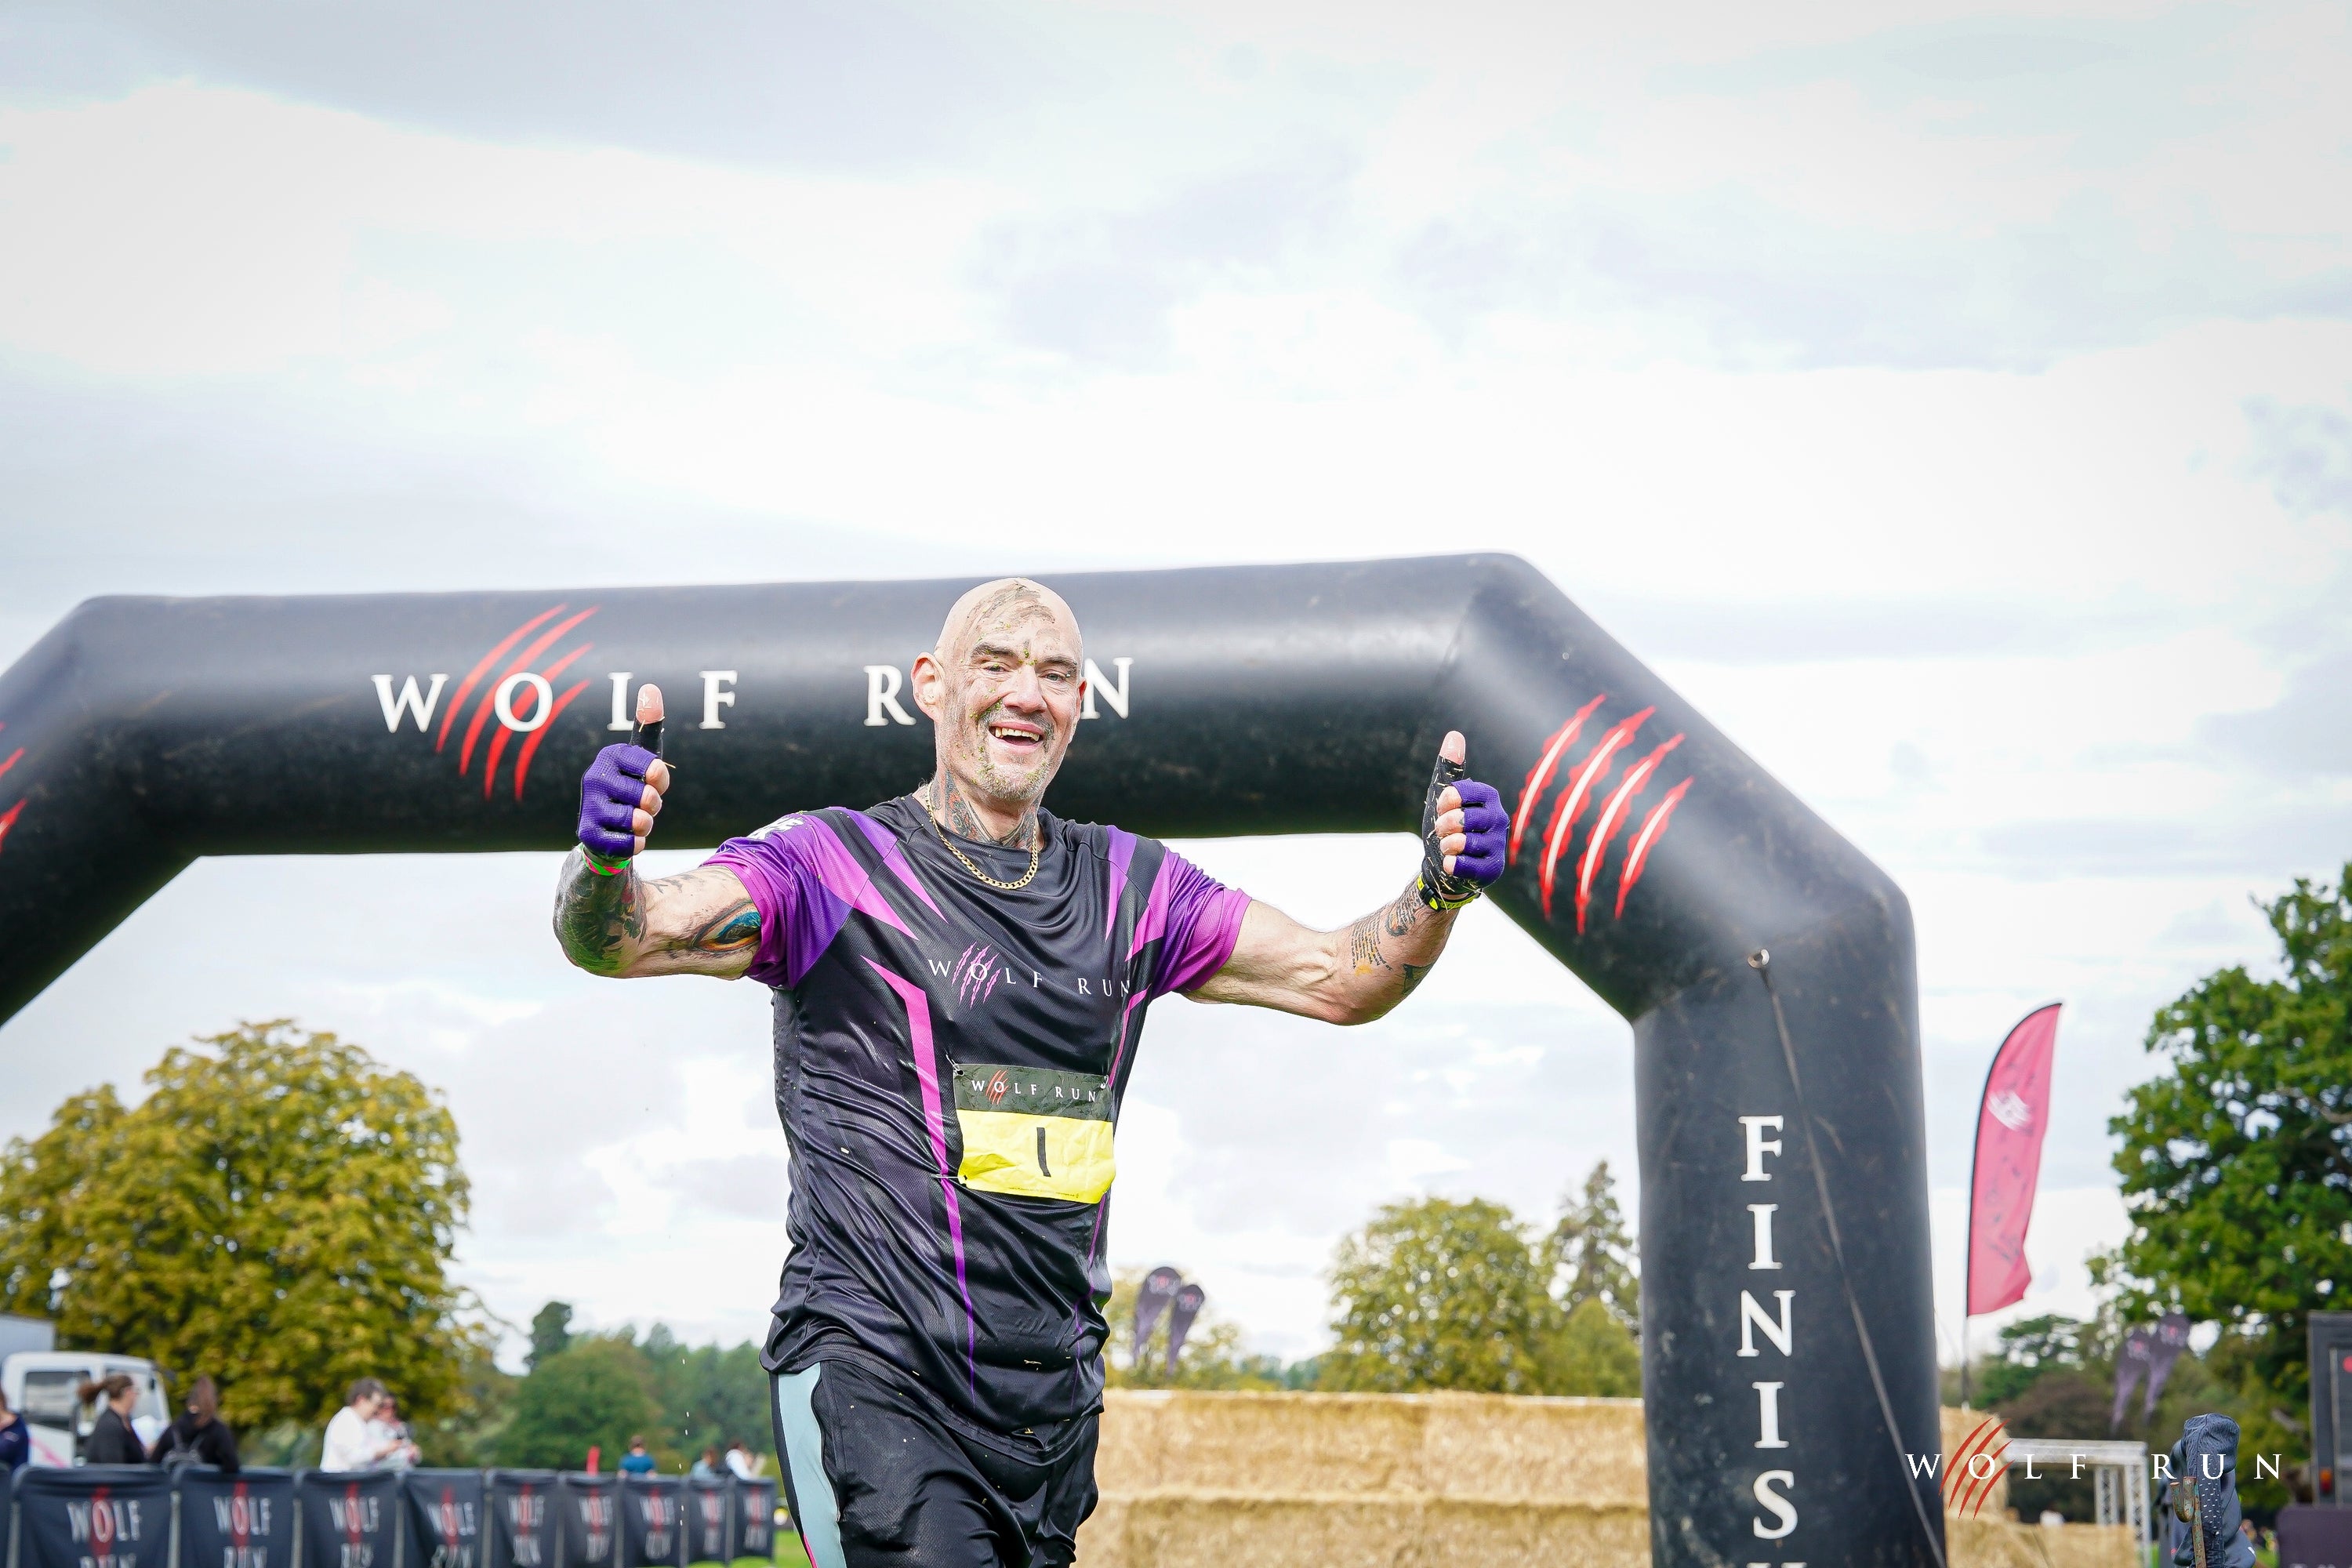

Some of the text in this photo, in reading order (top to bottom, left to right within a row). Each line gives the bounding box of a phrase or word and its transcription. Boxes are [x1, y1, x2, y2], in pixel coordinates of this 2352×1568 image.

[371, 656, 1134, 733] WOLF RN
[927, 959, 1131, 997] WOLF RUN
[971, 1080, 1097, 1102] WOLF RUN
[1036, 1127, 1051, 1178] 1
[1736, 1114, 1808, 1568] FINIS
[66, 1499, 141, 1543] WOLF
[212, 1496, 272, 1536] WOLF
